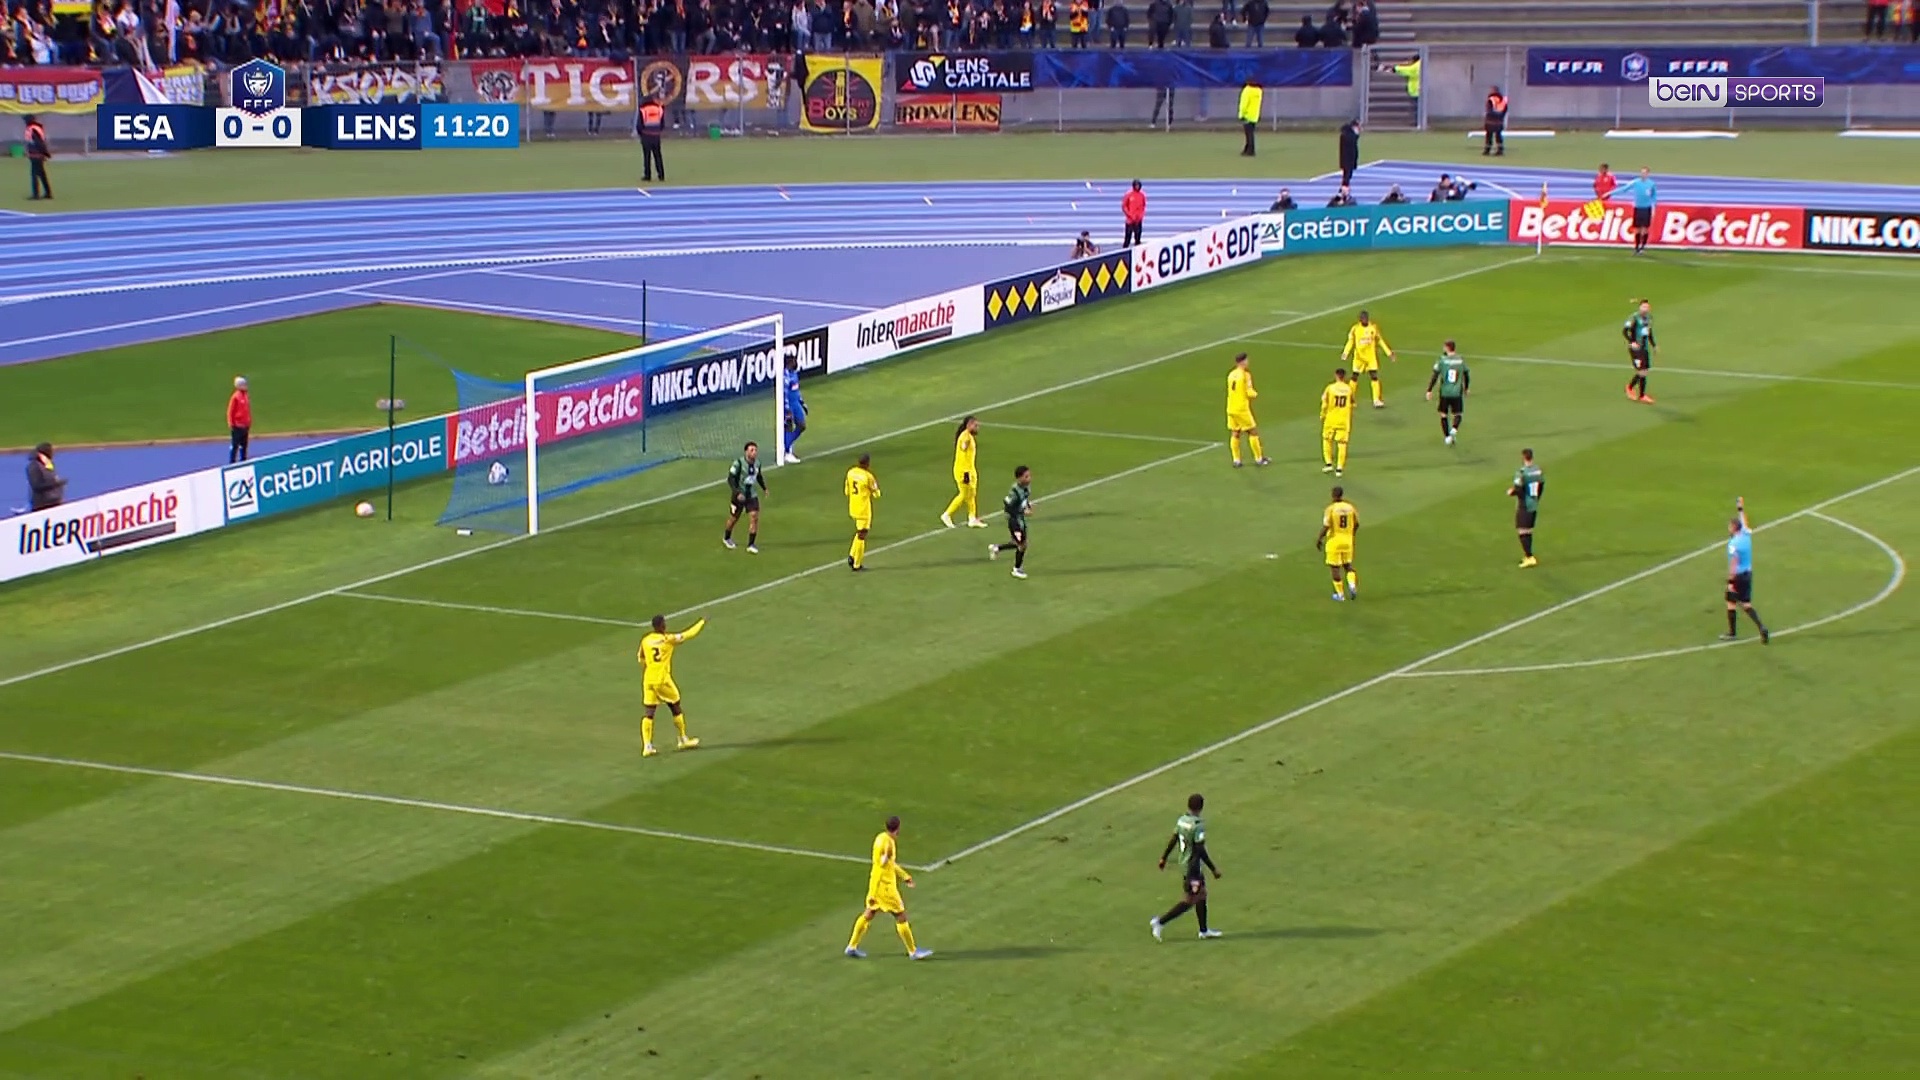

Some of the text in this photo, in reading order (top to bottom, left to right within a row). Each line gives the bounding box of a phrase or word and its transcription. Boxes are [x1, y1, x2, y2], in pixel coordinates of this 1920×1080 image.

[945, 58, 989, 72] LENS
[945, 72, 1030, 88] CAPITALE
[1287, 211, 1503, 241] CRÉDIT AGRICOLE
[1661, 210, 1791, 247] Betclic
[1811, 215, 1920, 248] NIKE.CO
[556, 379, 640, 436] Betclic
[259, 436, 442, 499] CRÉDIT AGRICOLE
